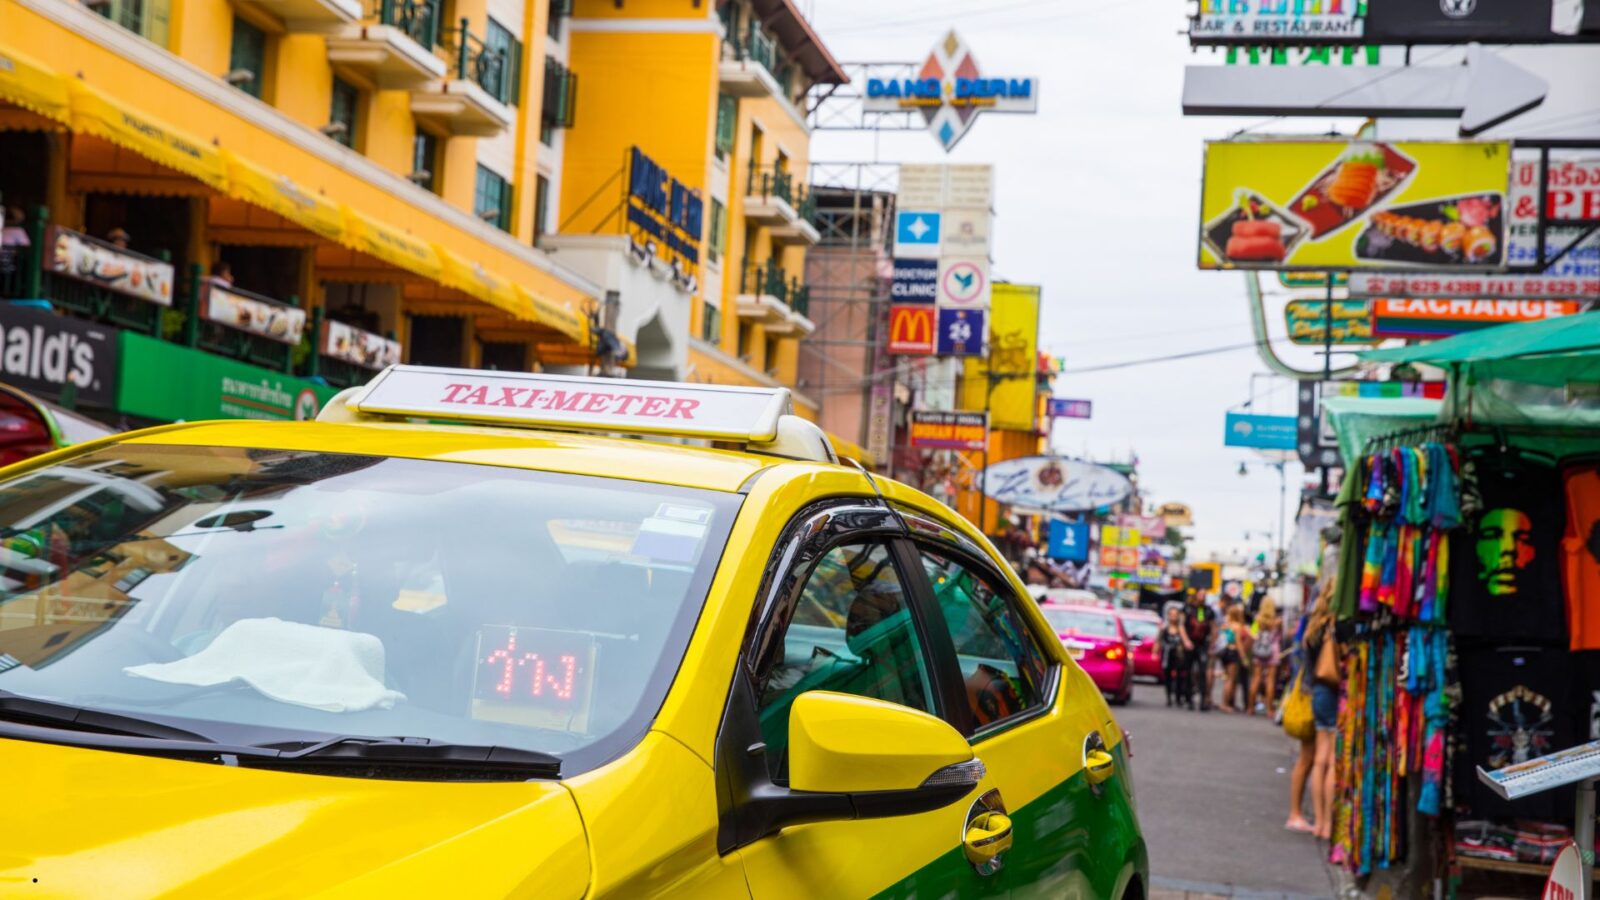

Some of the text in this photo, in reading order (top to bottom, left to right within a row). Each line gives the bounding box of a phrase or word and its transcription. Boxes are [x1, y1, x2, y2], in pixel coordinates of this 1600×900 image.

[1194, 20, 1355, 33] BAR & RESTAURANT
[892, 283, 937, 297] CLINIC
[1386, 298, 1564, 317] EXCHANGE
[0, 322, 94, 388] ald's
[440, 383, 700, 420] TAXI-METER
